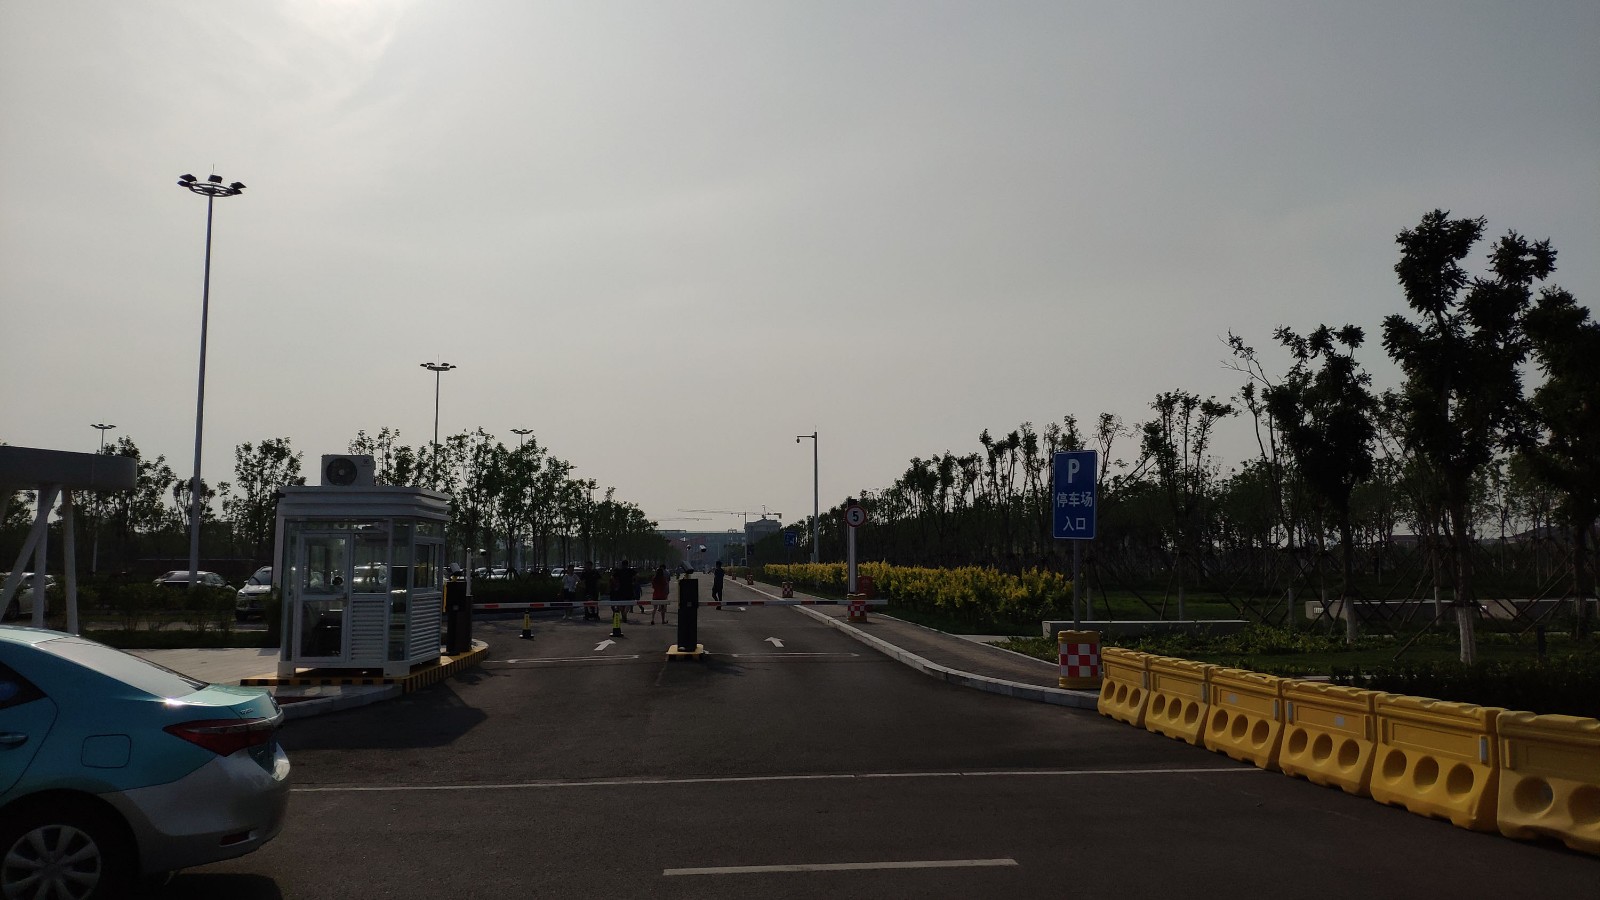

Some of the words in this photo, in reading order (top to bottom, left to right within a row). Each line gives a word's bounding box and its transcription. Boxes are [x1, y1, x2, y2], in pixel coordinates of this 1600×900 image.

[1067, 458, 1080, 484] P
[1056, 491, 1093, 508] 停车场
[852, 510, 859, 522] 5
[1062, 515, 1086, 532] 入口
